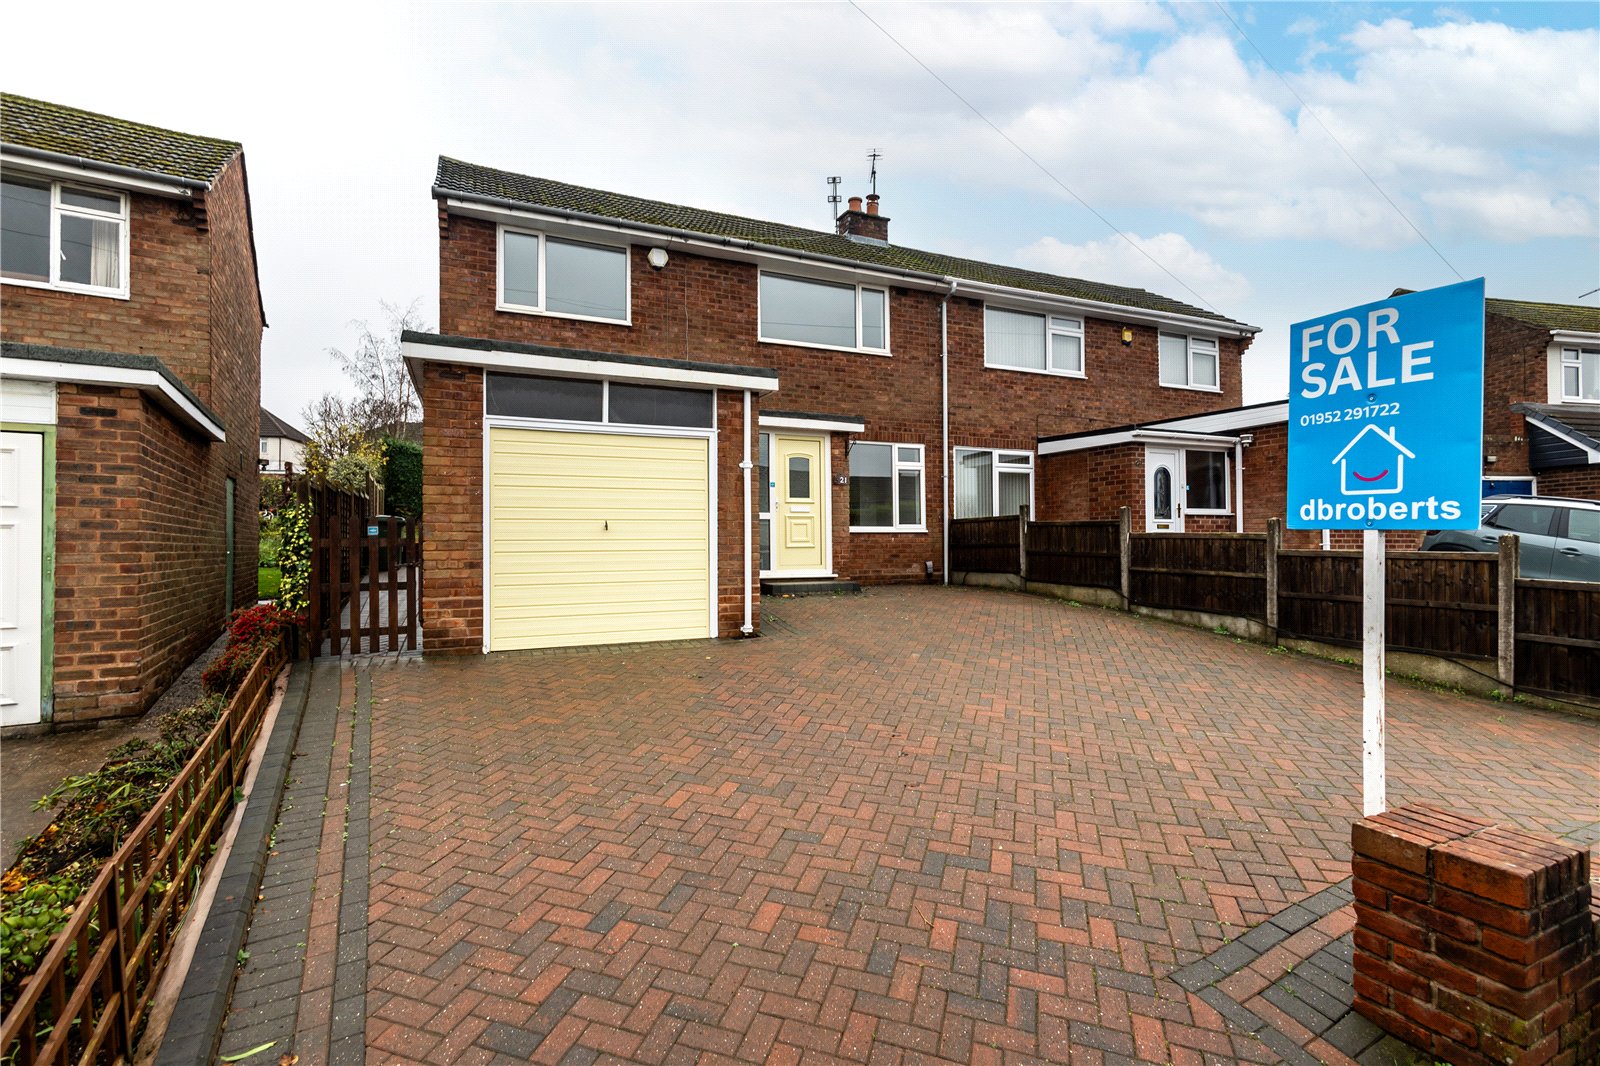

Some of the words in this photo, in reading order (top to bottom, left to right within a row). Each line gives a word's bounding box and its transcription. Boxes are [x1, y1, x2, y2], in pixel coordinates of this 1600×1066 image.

[1302, 307, 1400, 362] FOR
[1301, 341, 1434, 399] SALE
[1300, 410, 1341, 427] 01952
[1344, 402, 1400, 421] 291722
[839, 476, 847, 484] 21
[1300, 496, 1462, 521] dbroberts
